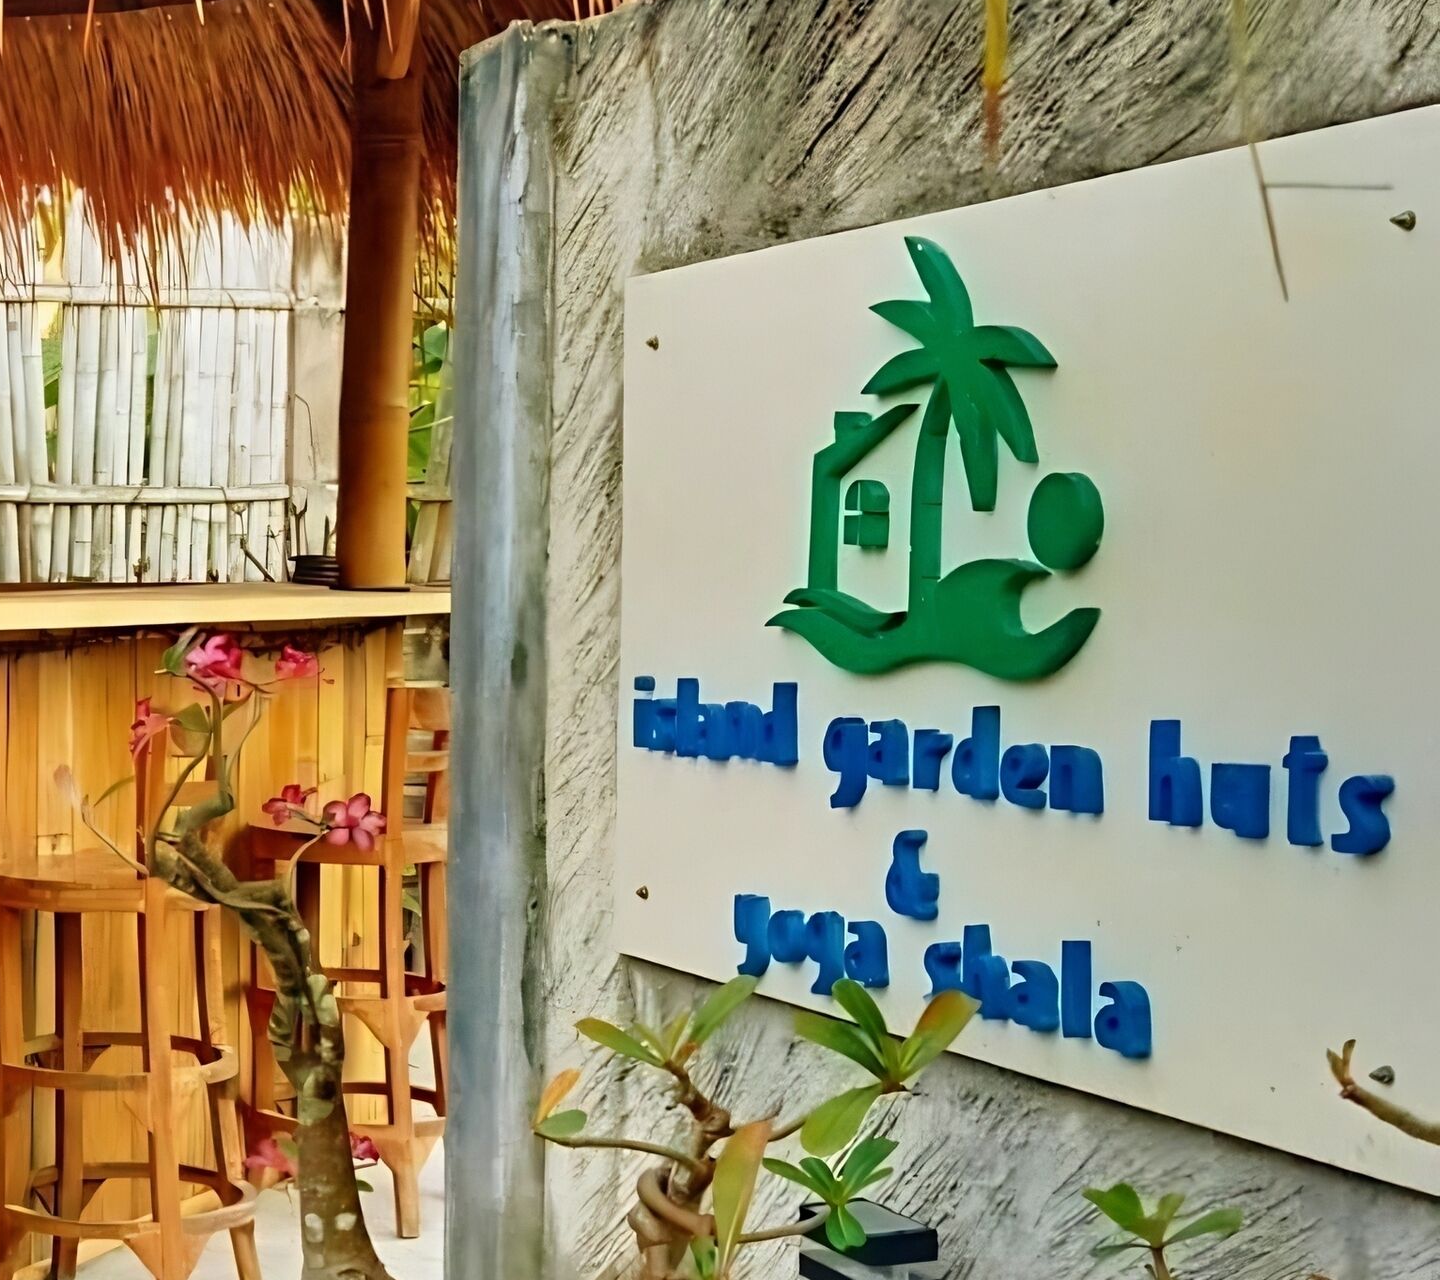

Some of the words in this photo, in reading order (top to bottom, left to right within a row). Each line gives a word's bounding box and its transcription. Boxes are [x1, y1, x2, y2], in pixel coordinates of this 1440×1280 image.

[633, 675, 800, 768] island
[822, 706, 1106, 816] garden
[1147, 719, 1396, 856] huts
[884, 829, 941, 922] &
[733, 893, 891, 996] yoga
[923, 923, 1153, 1060] shala
